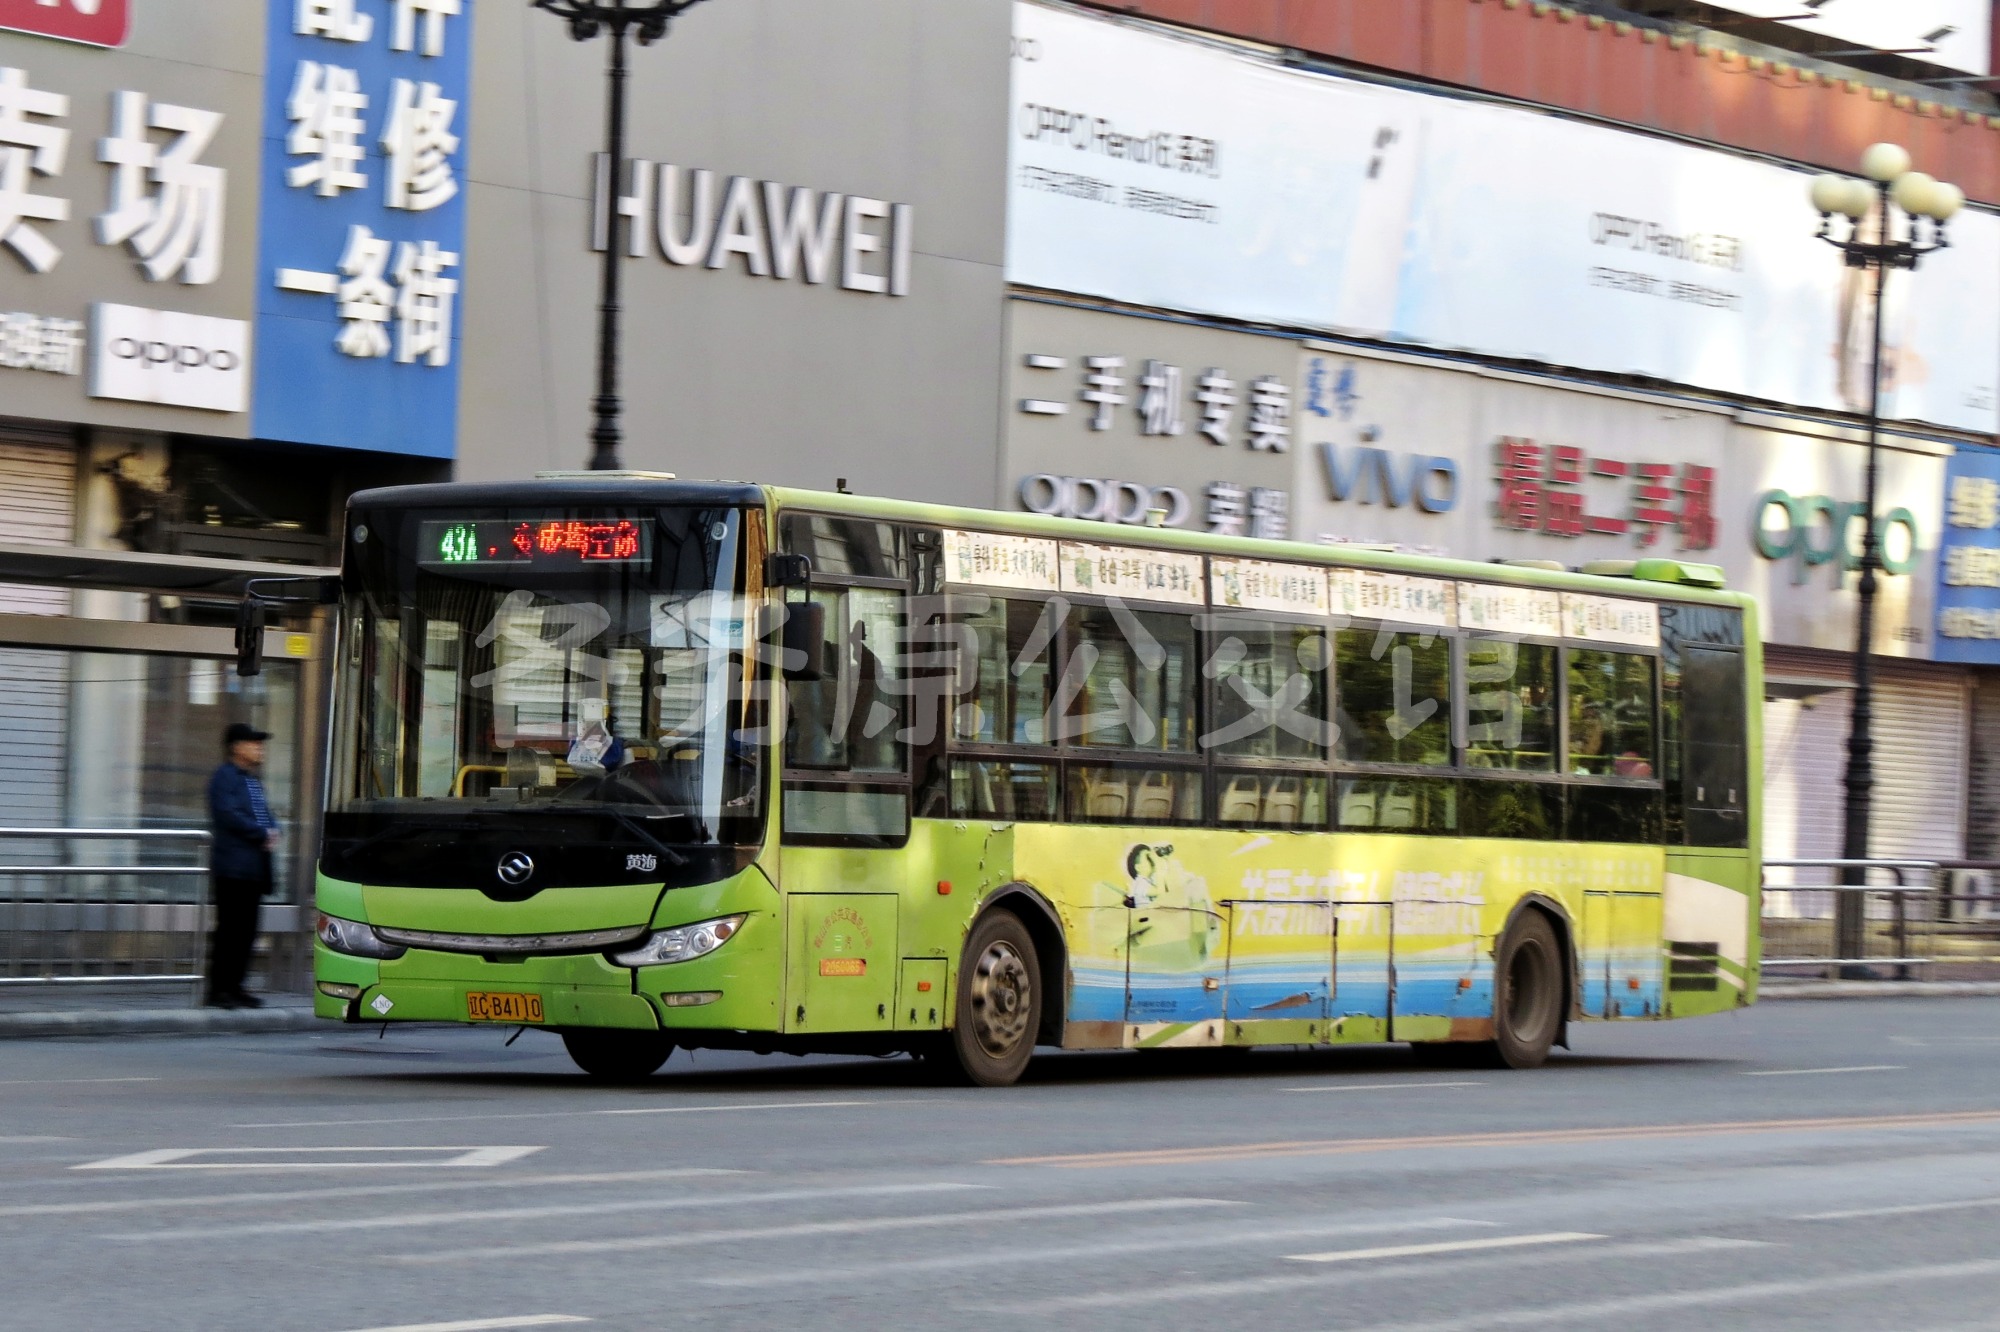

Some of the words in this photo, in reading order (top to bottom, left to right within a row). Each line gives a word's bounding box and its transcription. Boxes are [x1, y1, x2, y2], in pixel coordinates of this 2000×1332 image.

[286, 60, 460, 210] 维修
[592, 151, 913, 296] HUAWEI
[275, 224, 459, 367] 一条街
[1020, 352, 1292, 454] 二手机专卖
[1494, 434, 1718, 552] 精品二手机
[625, 853, 657, 871] 黄海
